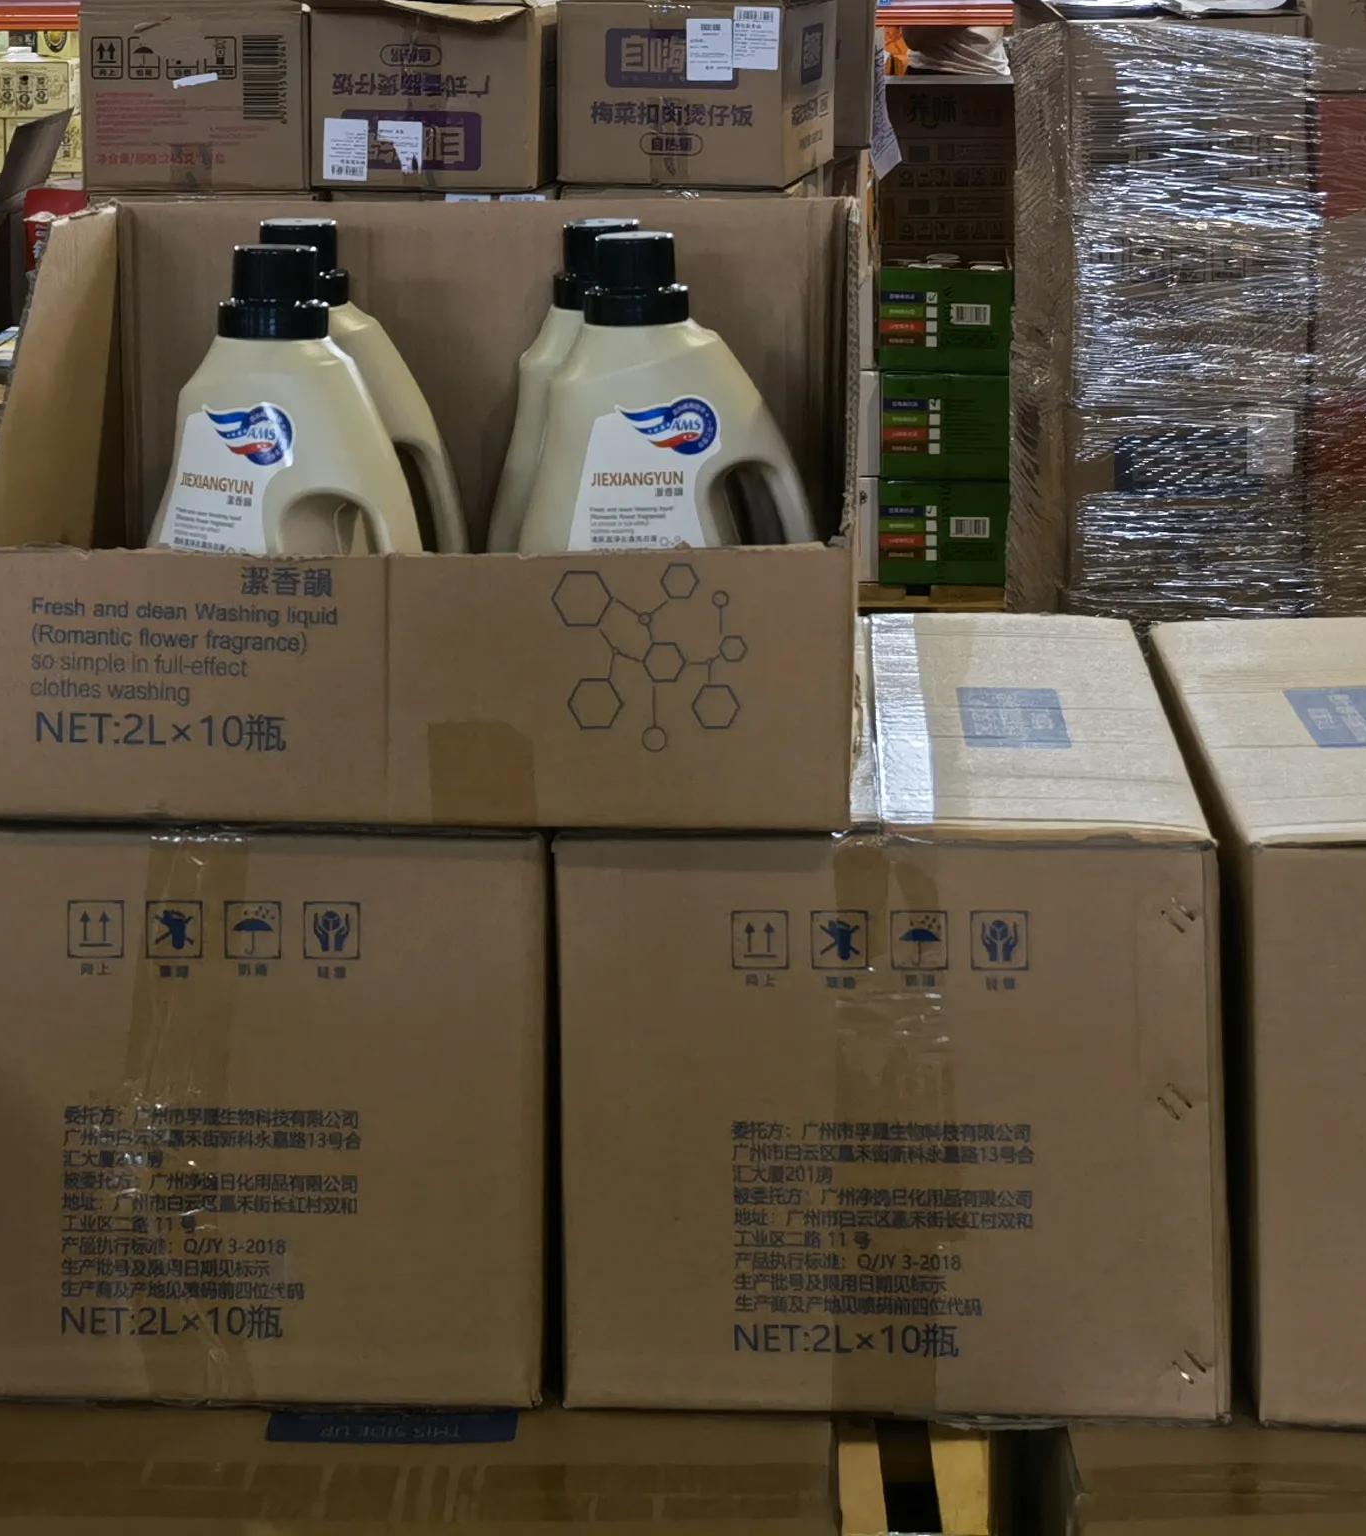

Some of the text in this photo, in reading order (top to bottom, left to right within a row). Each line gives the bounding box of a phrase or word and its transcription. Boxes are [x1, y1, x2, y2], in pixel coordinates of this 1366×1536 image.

[621, 34, 686, 74] 自嗨
[331, 73, 491, 98] 广式香肠煲仔饭
[590, 101, 754, 128] 梅菜扣肉煲仔饭
[670, 417, 702, 432] AMS
[179, 471, 255, 496] JIEXIANGYUN
[590, 470, 684, 488] JIEXIANGYUN
[31, 596, 339, 630] Fresh and clean Washing liquid
[31, 622, 308, 656] (Romantic flower fragrance)
[30, 653, 248, 678] so simple in full-effect
[30, 677, 191, 708] clothes washing
[33, 710, 287, 754] NET:2L×10瓶
[60, 1302, 284, 1340] NET:2L×10瓶
[733, 1323, 960, 1359] NET:2L×10瓶
